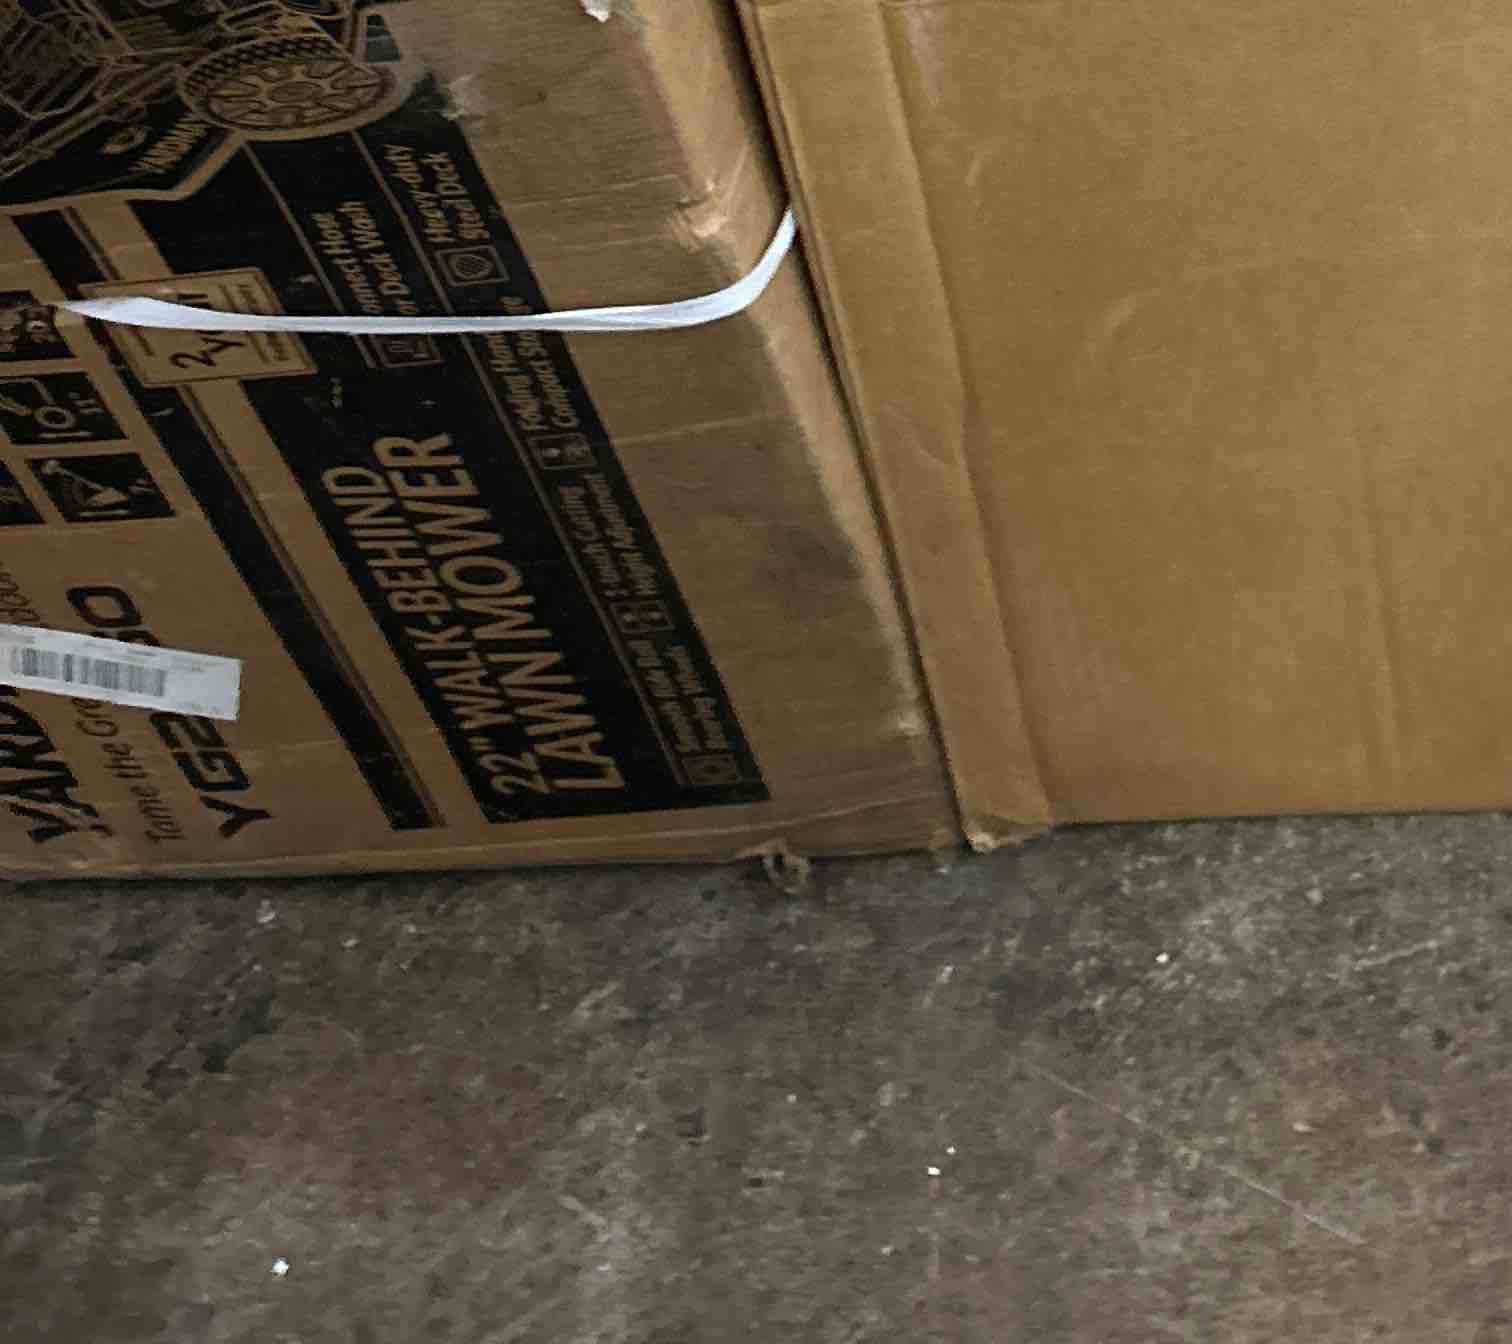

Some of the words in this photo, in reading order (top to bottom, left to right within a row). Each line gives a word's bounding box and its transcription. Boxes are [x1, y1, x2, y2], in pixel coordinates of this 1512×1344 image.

[333, 256, 384, 315] onnect
[373, 431, 552, 639] MOWER
[320, 465, 515, 730] WALK-BEHIND
[101, 742, 149, 779] the
[474, 735, 553, 795] 22"
[485, 650, 626, 790] LAWN
